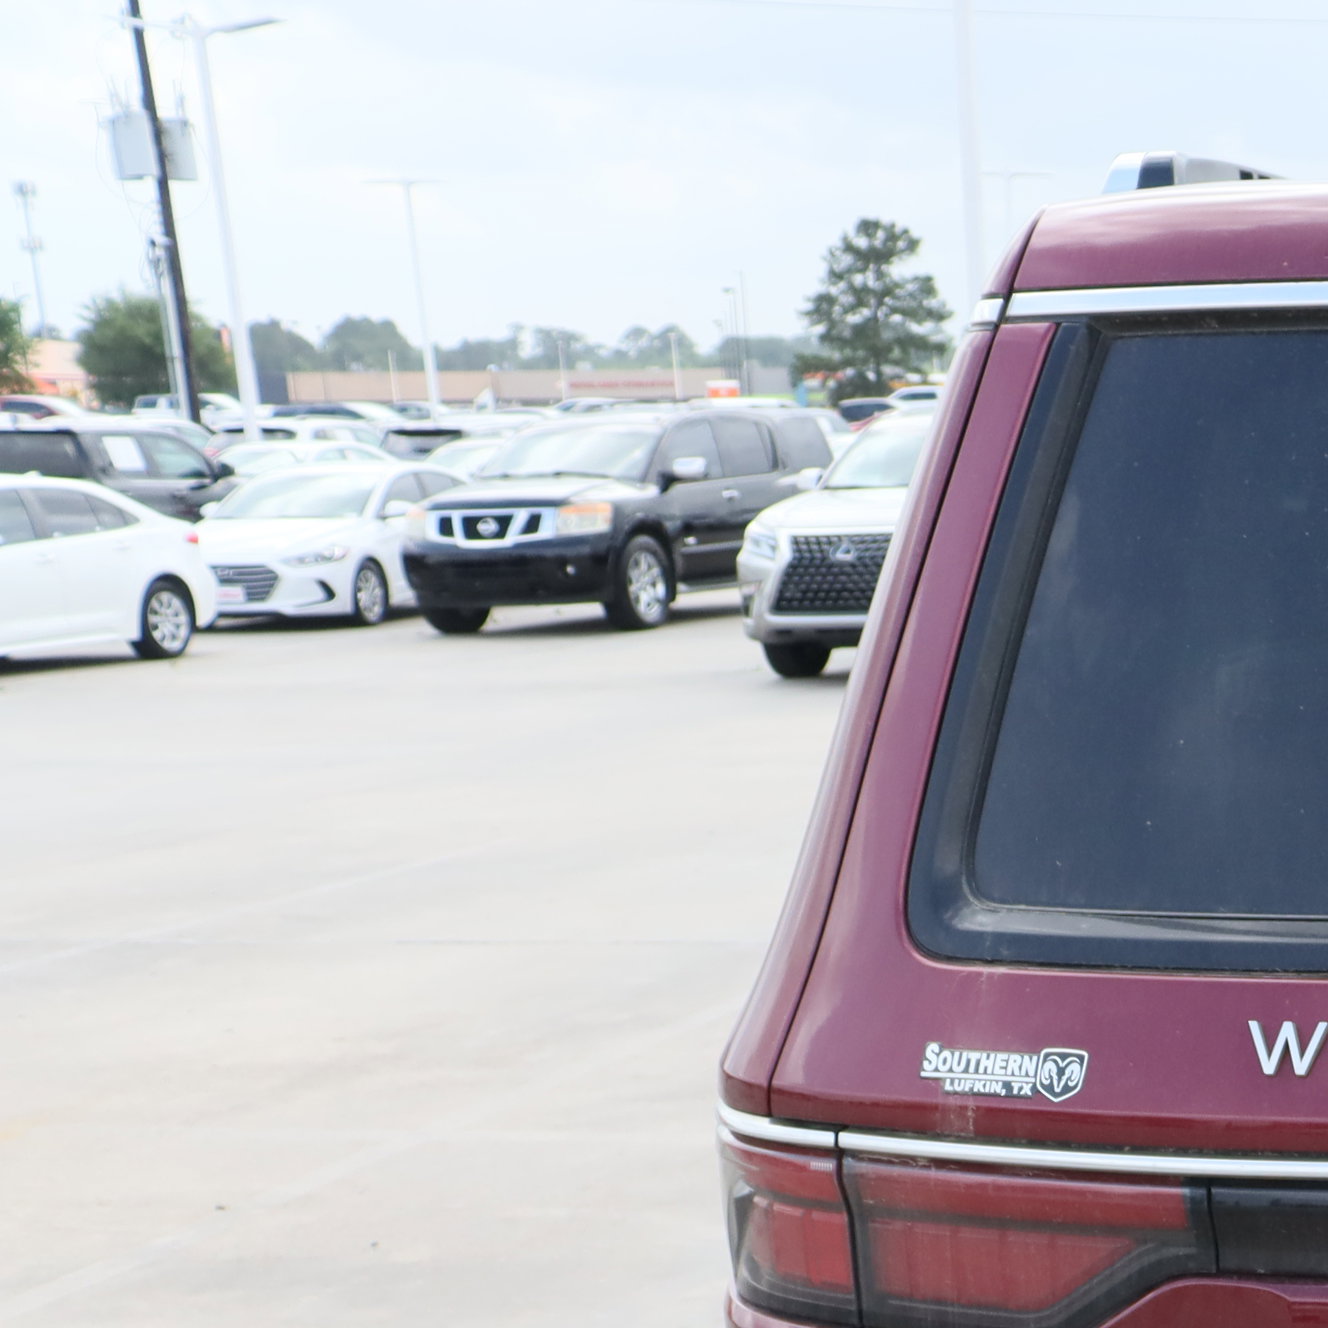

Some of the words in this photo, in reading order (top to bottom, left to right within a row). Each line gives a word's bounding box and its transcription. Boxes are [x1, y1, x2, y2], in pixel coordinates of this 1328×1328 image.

[922, 1043, 1038, 1077] SOUTHERN
[944, 1078, 1006, 1097] LUFKIN,
[1011, 1082, 1033, 1096] TX
